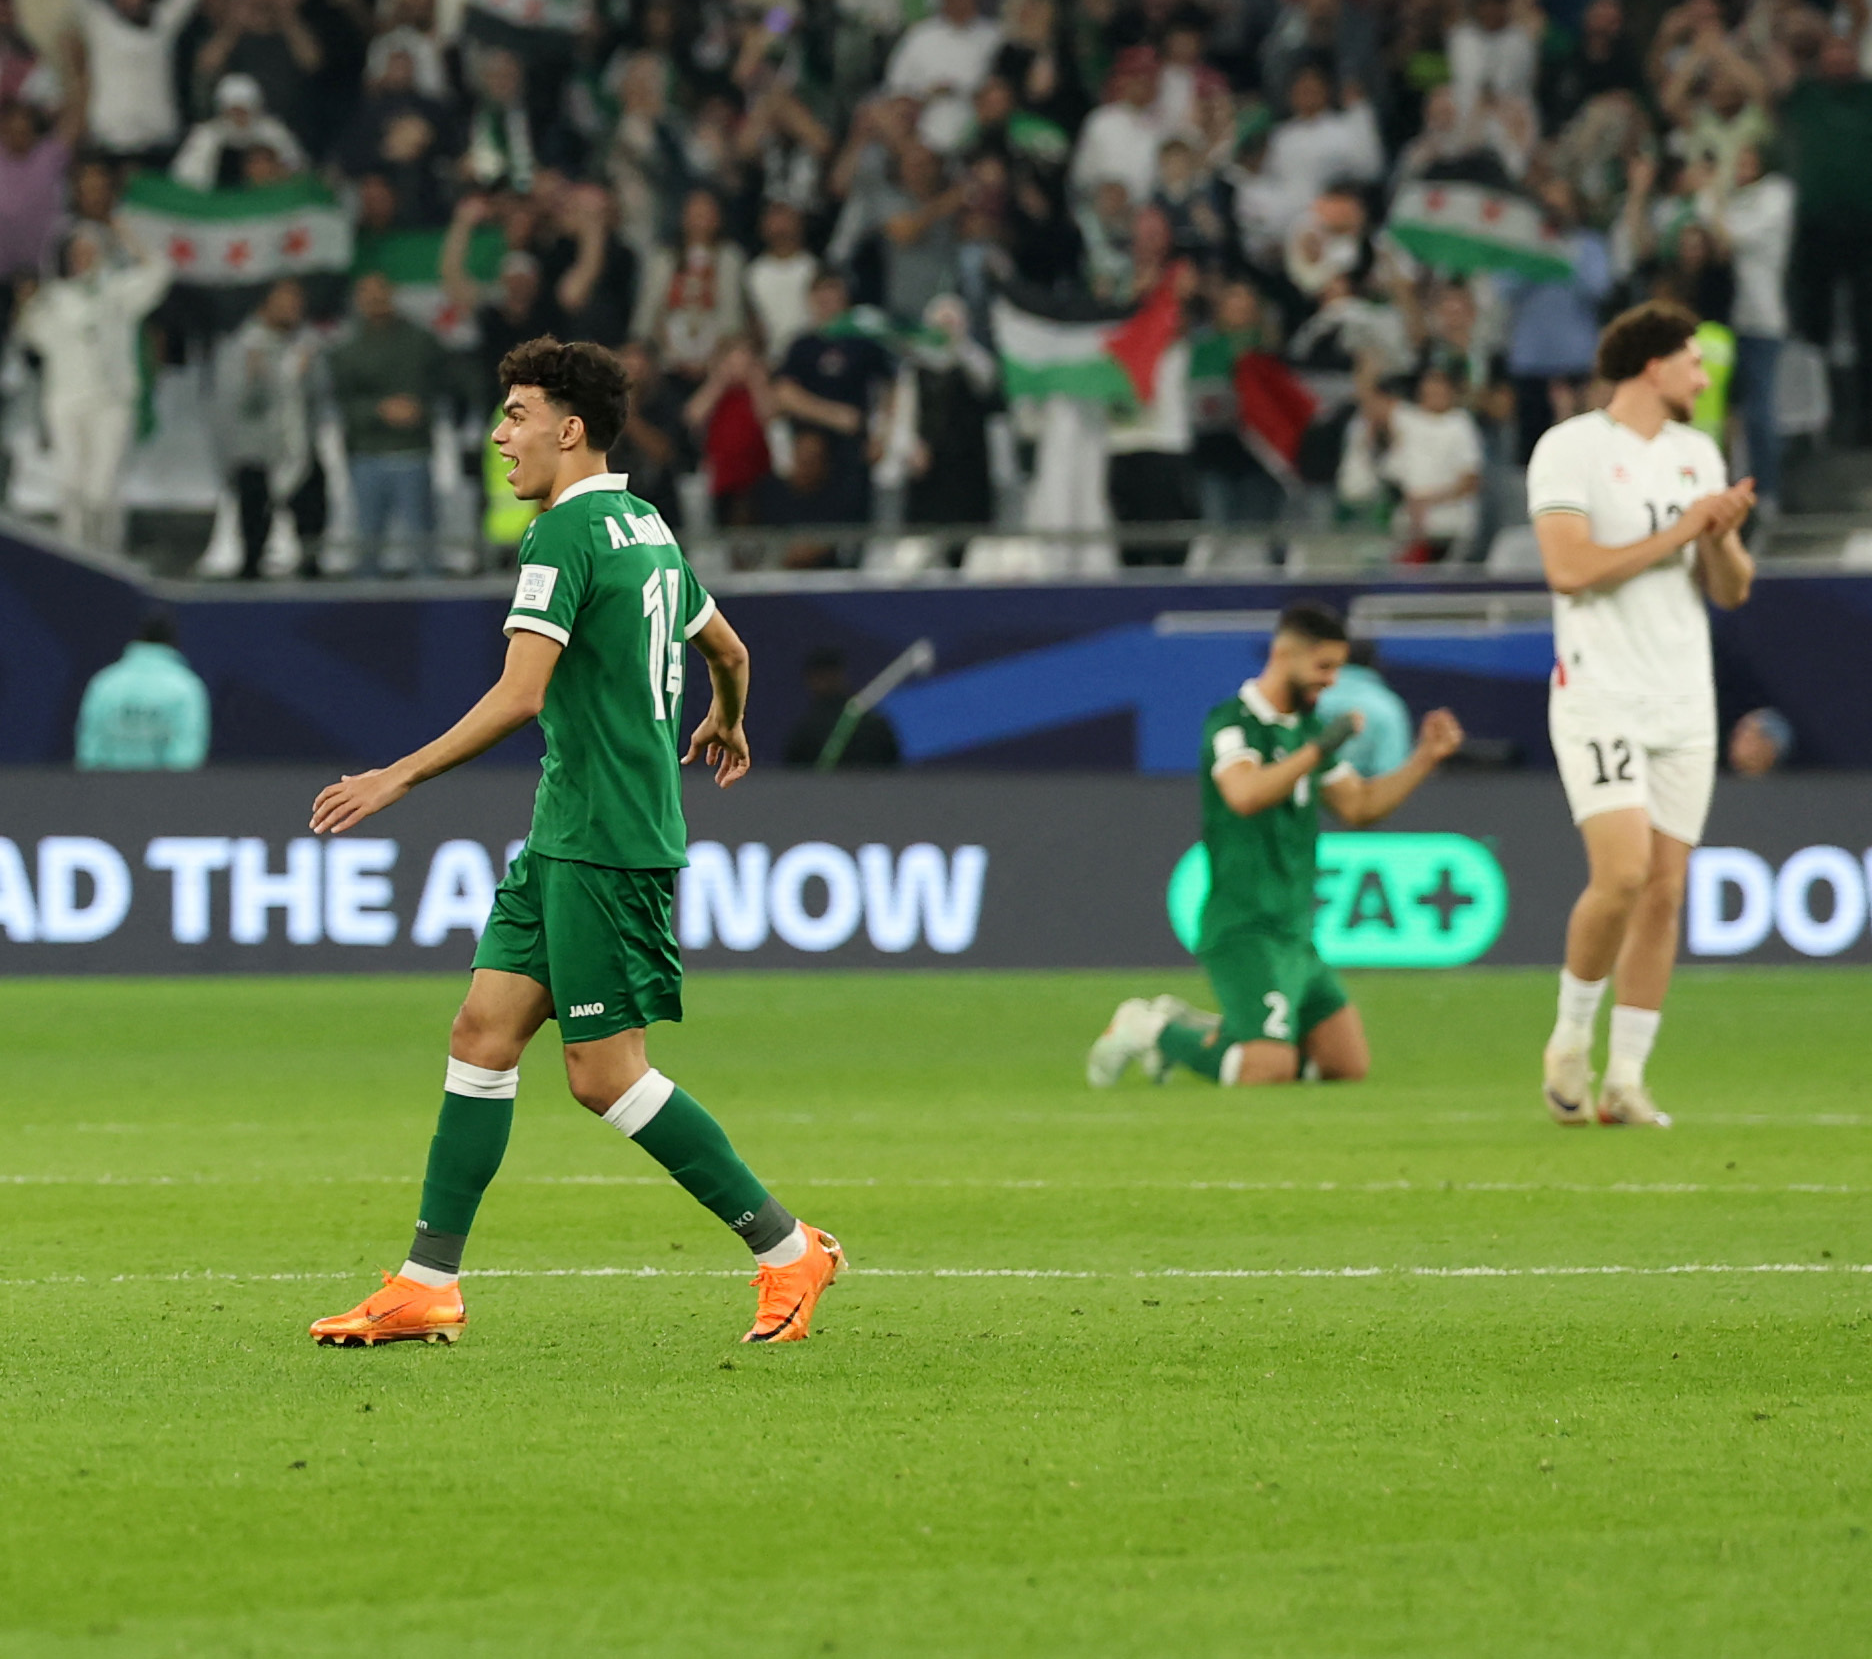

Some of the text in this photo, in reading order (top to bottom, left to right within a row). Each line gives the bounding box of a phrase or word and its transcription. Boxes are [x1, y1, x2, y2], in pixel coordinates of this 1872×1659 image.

[1585, 736, 1633, 787] 12
[144, 836, 399, 946] THE
[681, 841, 989, 954] NOW
[1688, 844, 1872, 957] DO
[568, 1002, 605, 1018] JAKO
[1263, 989, 1291, 1040] 2
